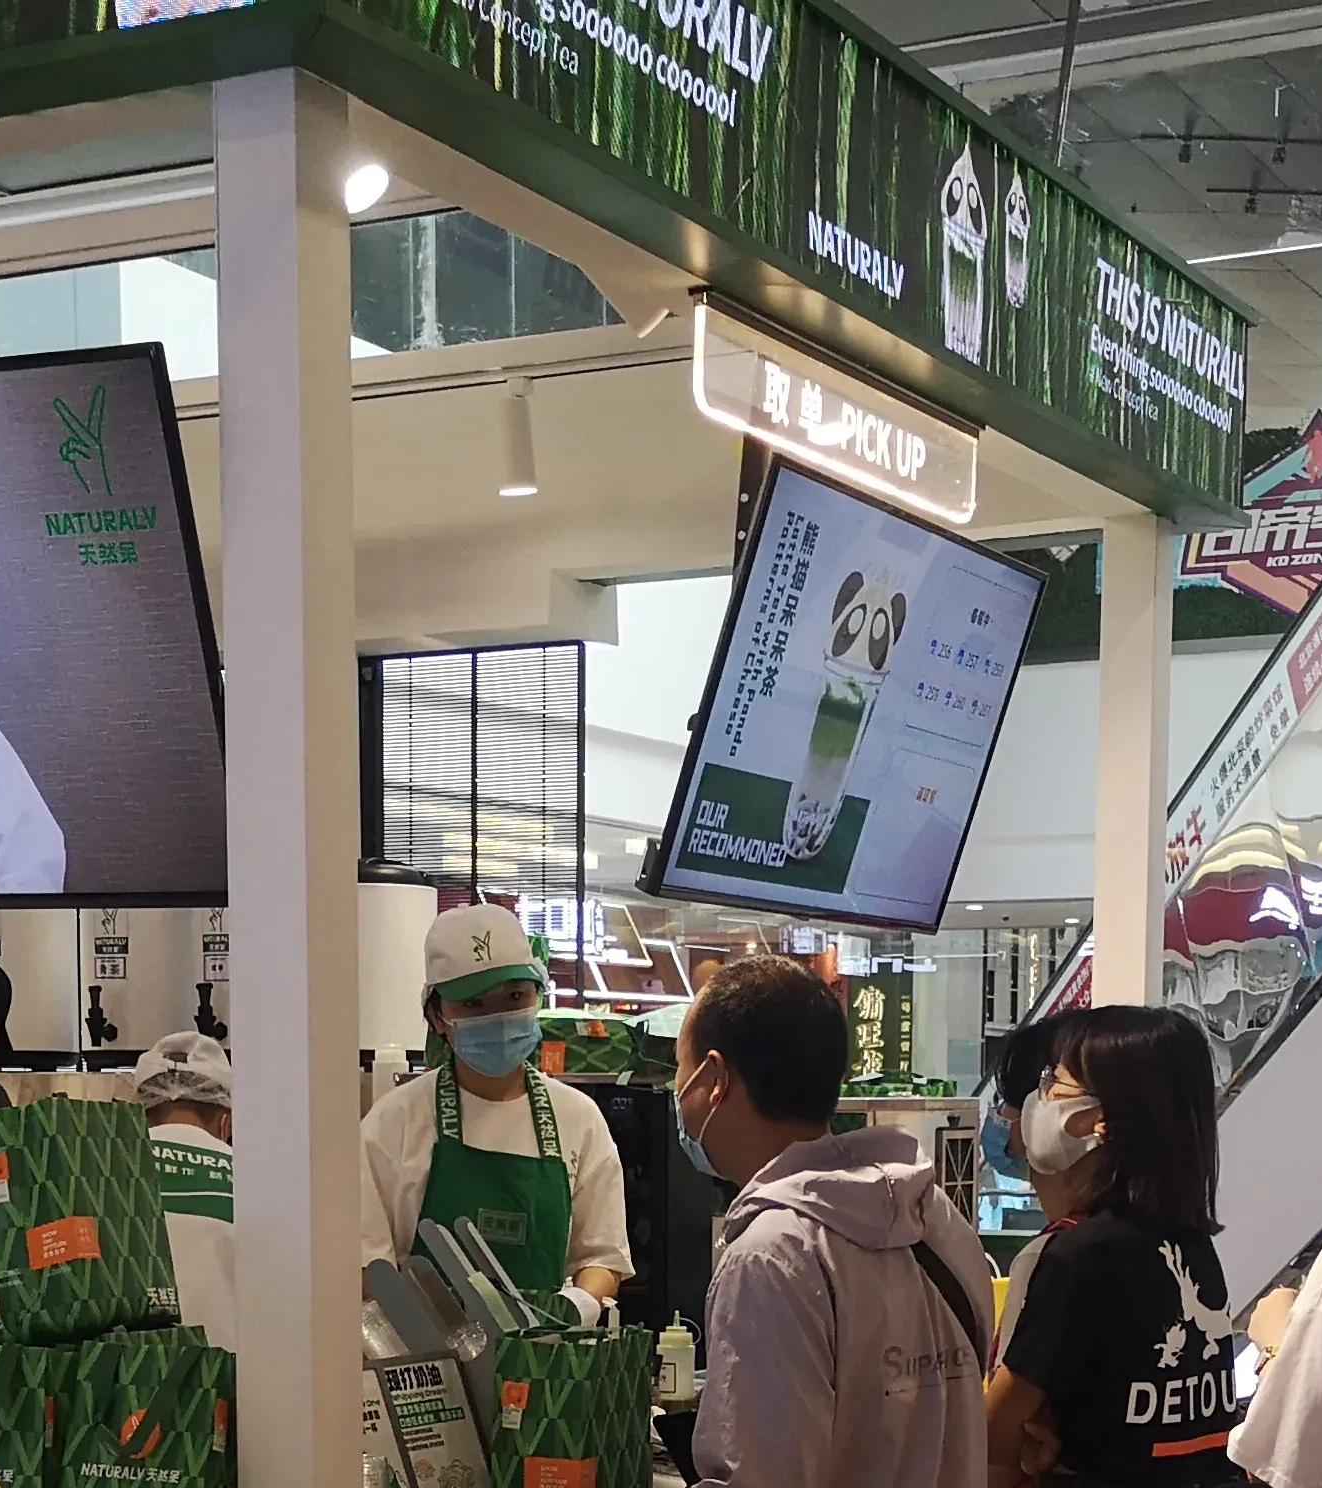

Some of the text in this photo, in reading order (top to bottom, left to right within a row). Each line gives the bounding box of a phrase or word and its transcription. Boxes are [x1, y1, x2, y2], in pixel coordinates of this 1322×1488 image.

[552, 35, 580, 75] Tea
[808, 210, 905, 299] NATURALV
[1096, 256, 1142, 333] THIS
[1140, 290, 1162, 345] IS
[1090, 322, 1150, 392] Everything
[1145, 394, 1159, 421] Tea
[896, 427, 926, 481] UP
[44, 506, 158, 537] NATURALV
[77, 542, 140, 568] 天然呆
[695, 800, 730, 829] OUR
[150, 1145, 233, 1171] NATURA
[80, 1462, 146, 1481] NATURALV
